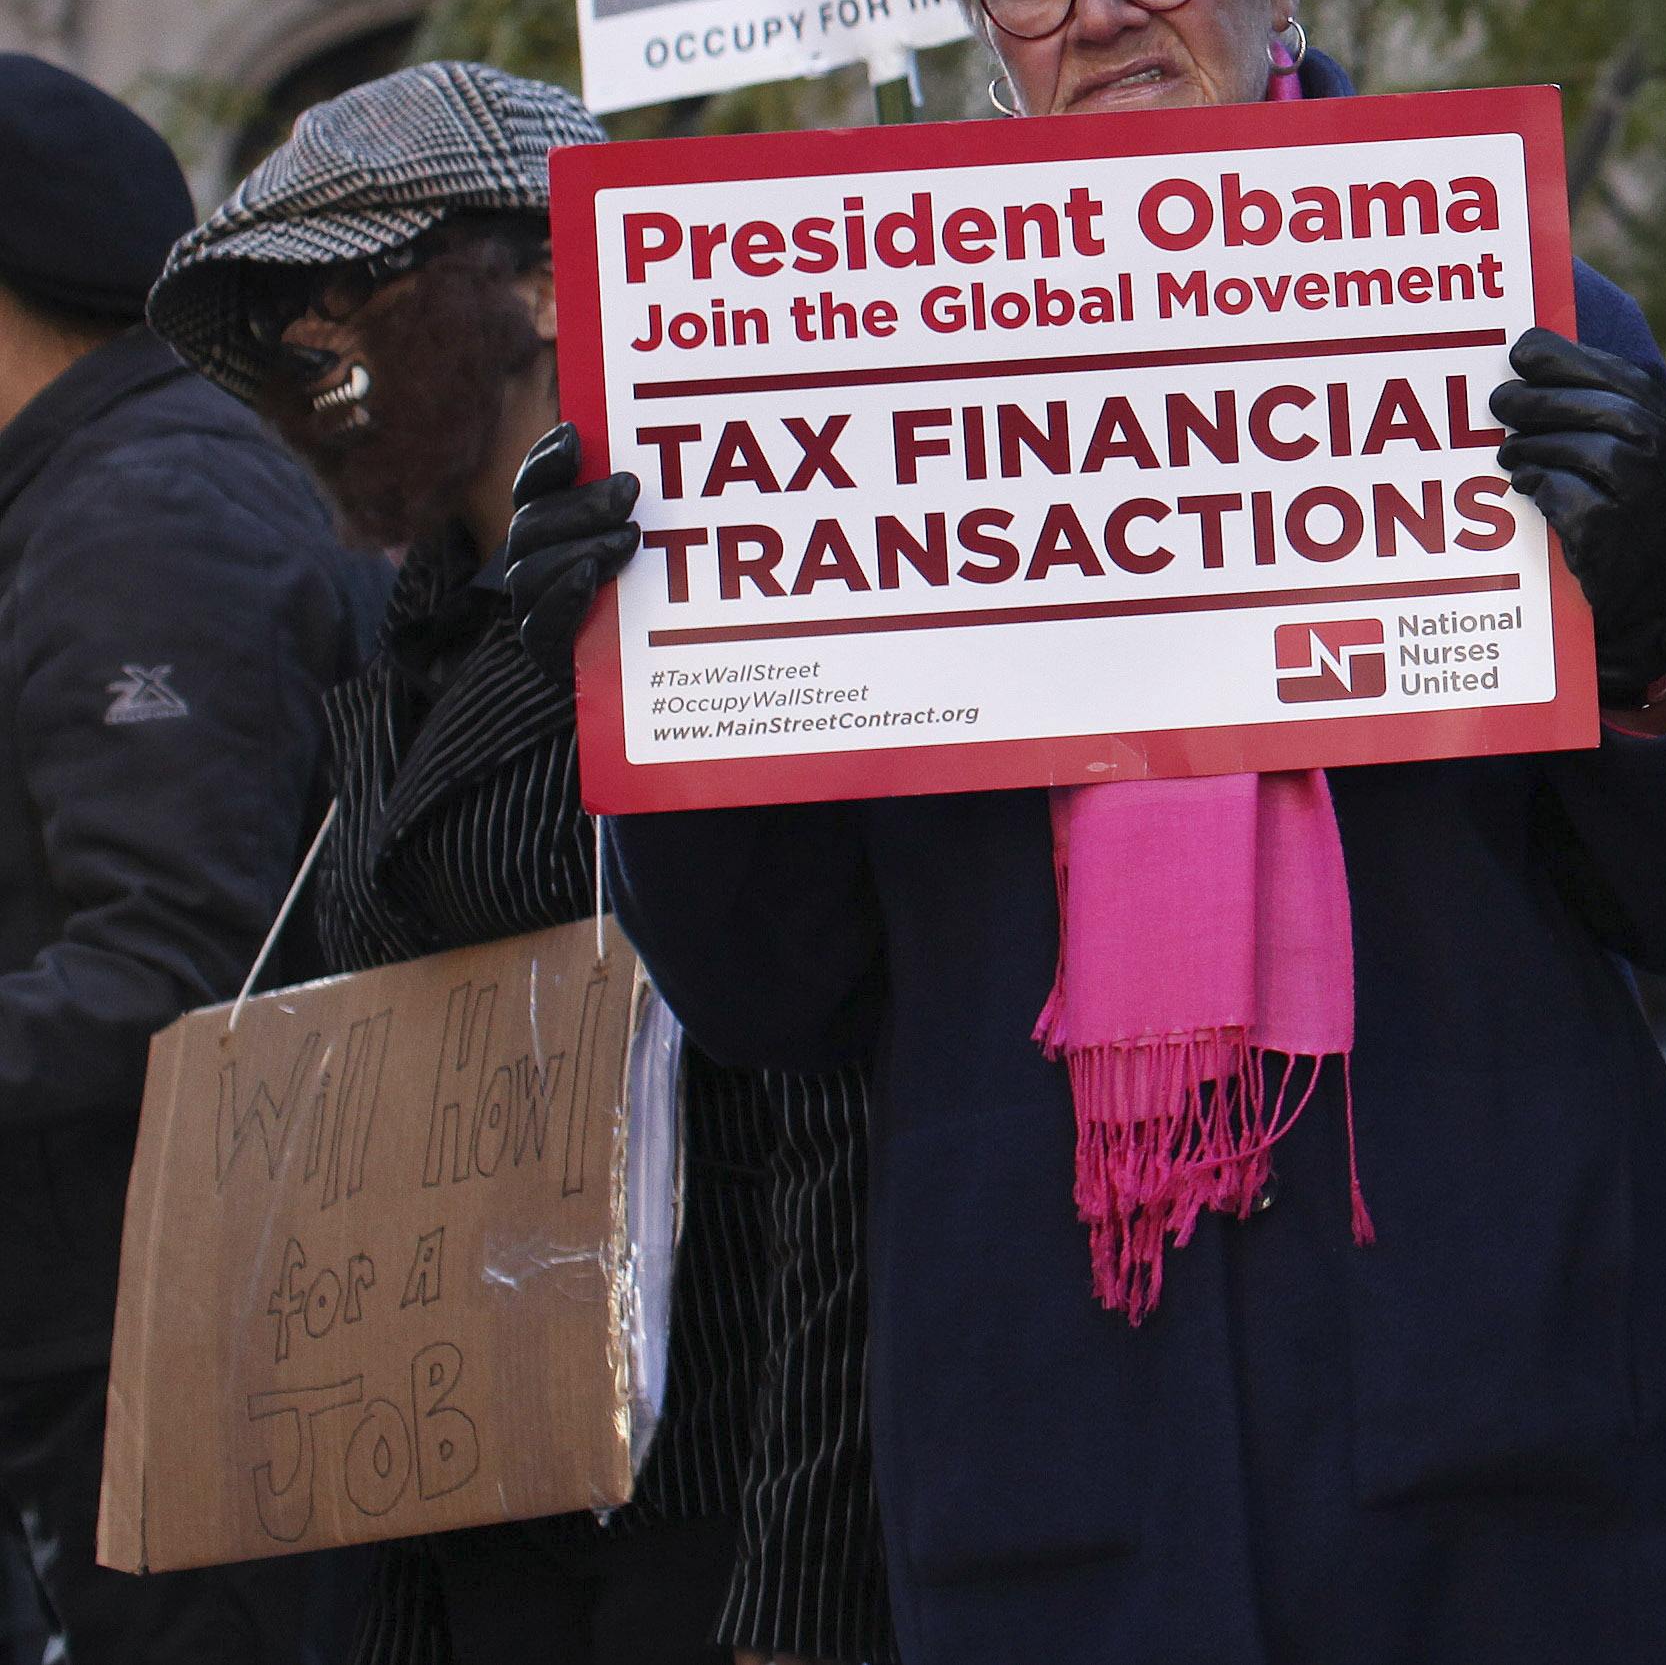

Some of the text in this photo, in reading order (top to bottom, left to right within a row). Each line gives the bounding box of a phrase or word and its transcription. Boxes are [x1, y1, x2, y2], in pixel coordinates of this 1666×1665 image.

[645, 9, 808, 72] OCCUPY
[621, 173, 1500, 285] President Obama
[630, 252, 1505, 353] Join the Global Movement
[635, 374, 1506, 502] TAX FINANCIAL
[642, 475, 1517, 603] TRANSACTIONS
[1398, 605, 1522, 638] National
[650, 661, 821, 688] #TaxWallStreet
[1399, 641, 1500, 668] Nurses
[1401, 666, 1499, 696] United
[651, 684, 869, 715] #OccupyWallStreet
[653, 706, 979, 741] www.MainStreetContract.org
[214, 1008, 393, 1210] Will
[267, 1238, 376, 1362] for
